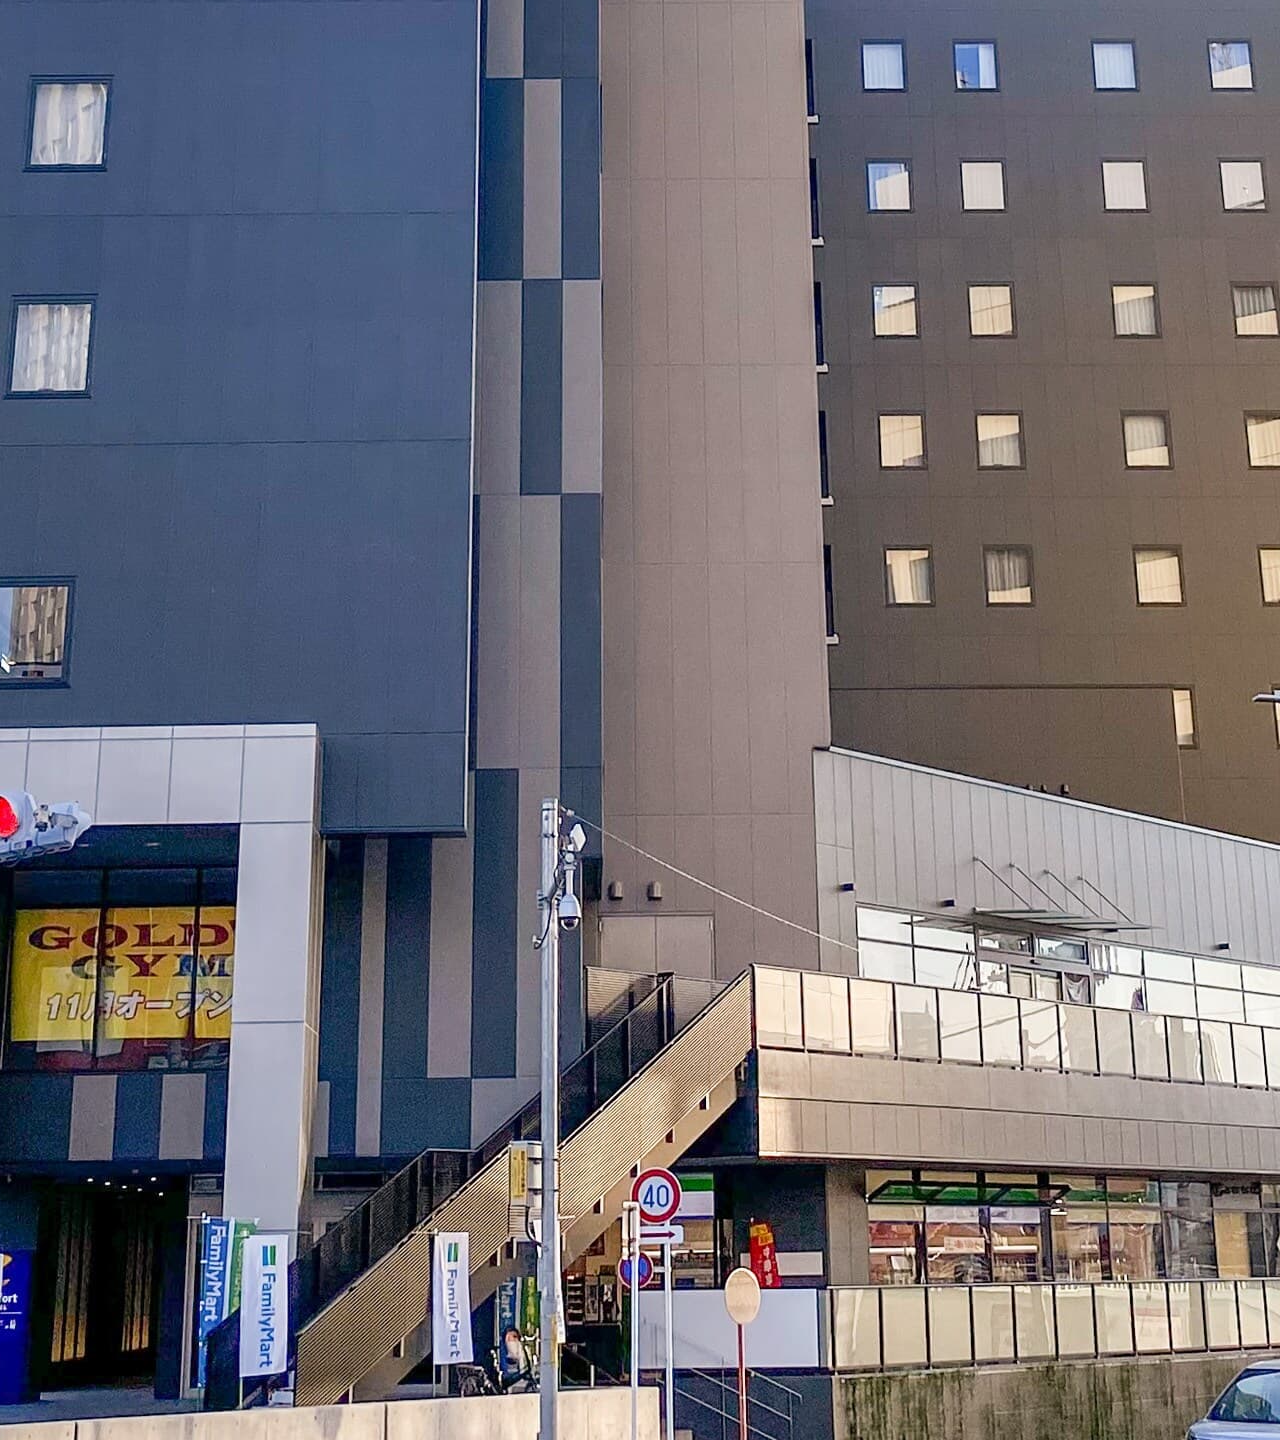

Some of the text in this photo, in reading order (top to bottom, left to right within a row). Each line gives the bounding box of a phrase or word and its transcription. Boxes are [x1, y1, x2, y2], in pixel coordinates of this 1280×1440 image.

[71, 953, 233, 979] GYM
[643, 1184, 669, 1208] 40
[204, 1224, 228, 1323] FamilyMart
[258, 1272, 277, 1369] FamilyMart
